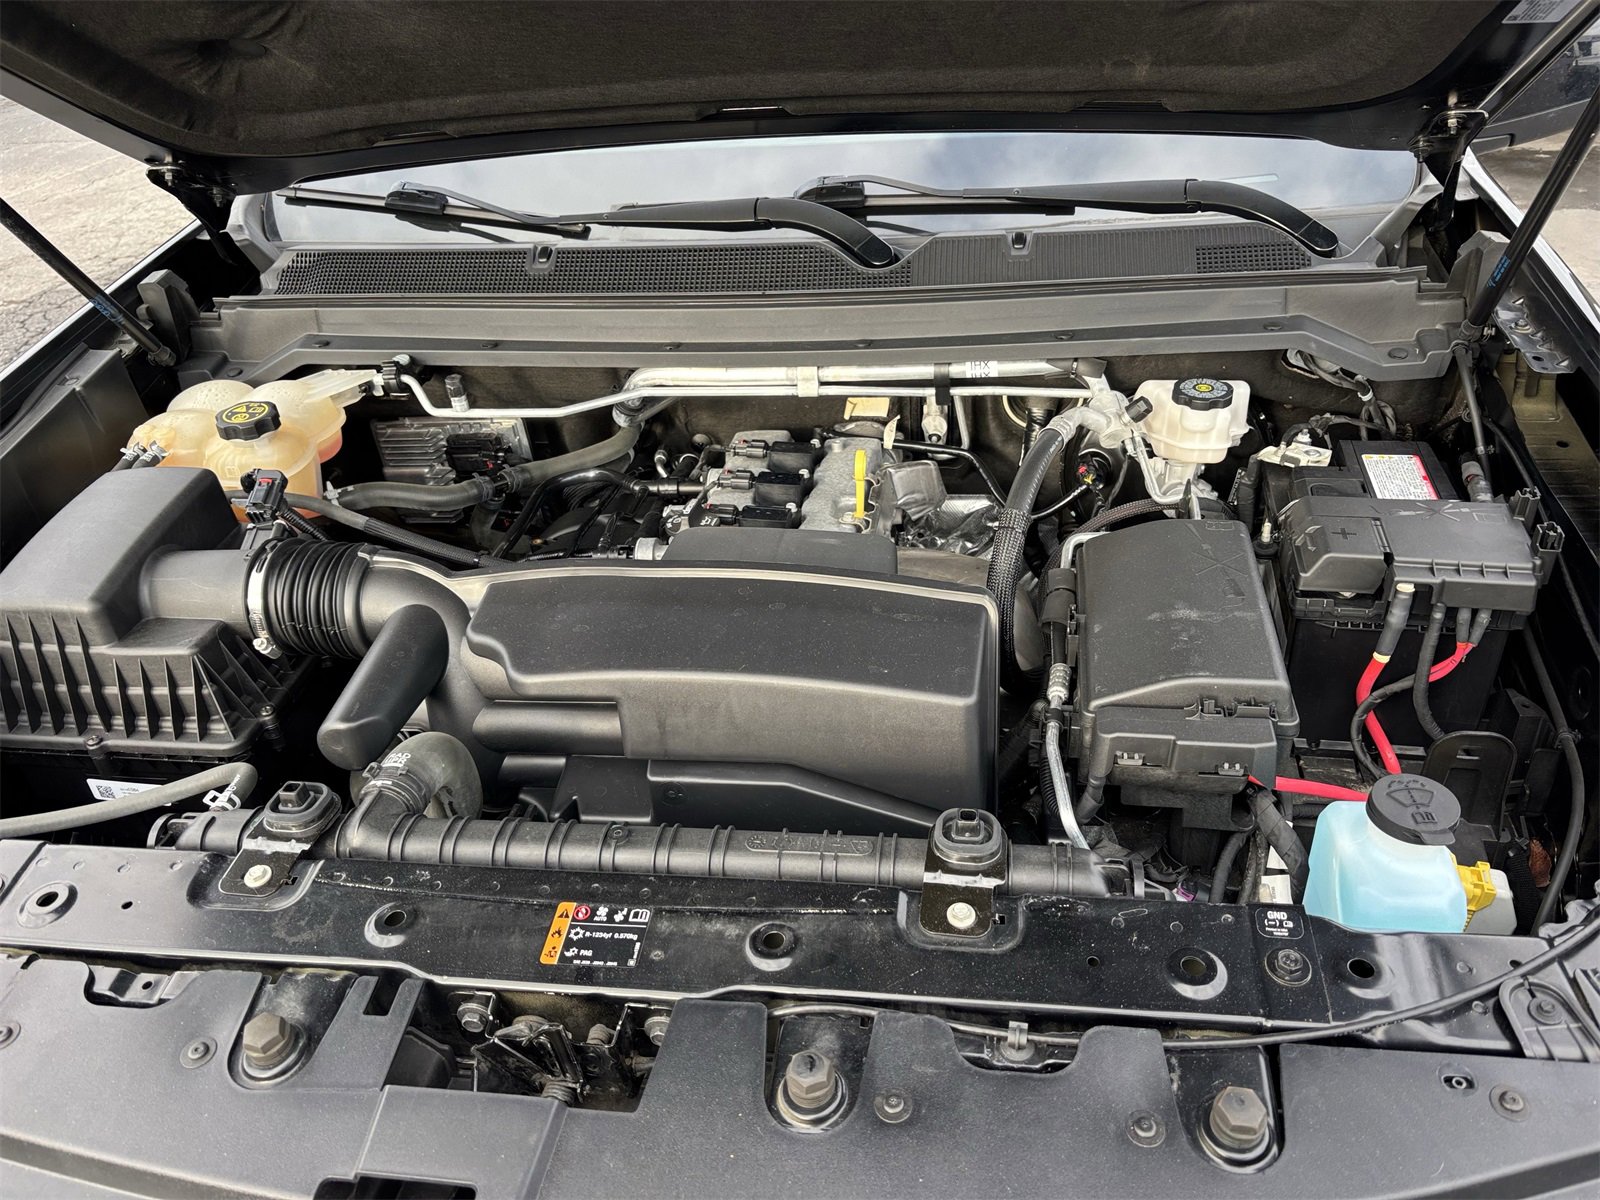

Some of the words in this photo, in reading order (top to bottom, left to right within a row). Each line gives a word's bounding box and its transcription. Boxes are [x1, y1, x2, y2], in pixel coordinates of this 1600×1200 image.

[970, 361, 990, 370] IHX
[1267, 911, 1287, 920] GND
[585, 931, 612, 939] R-1234yf
[614, 932, 638, 940] 0.570kg
